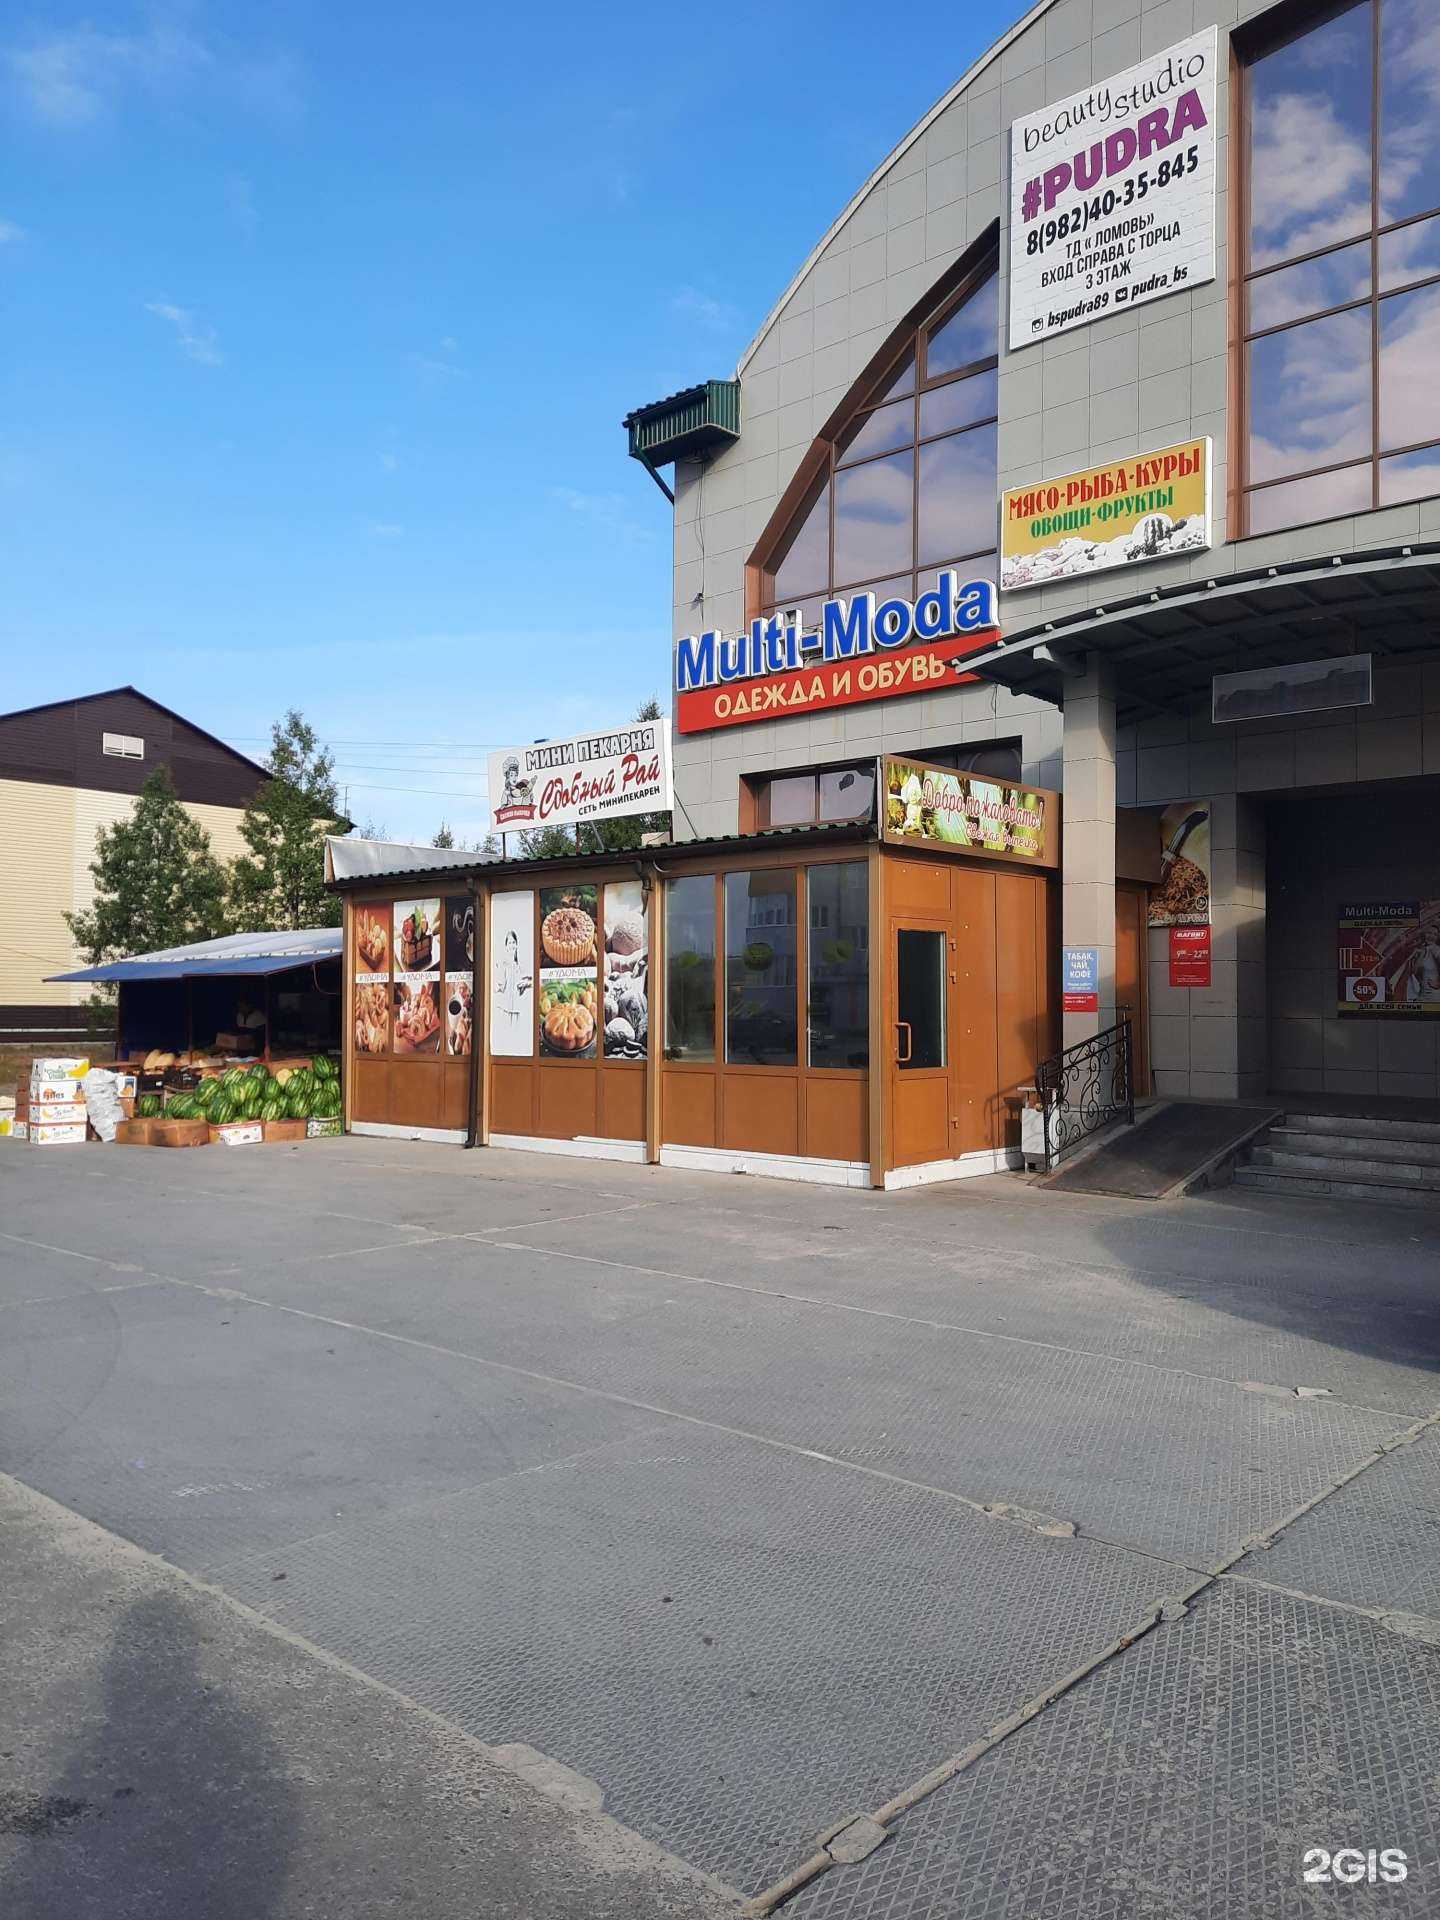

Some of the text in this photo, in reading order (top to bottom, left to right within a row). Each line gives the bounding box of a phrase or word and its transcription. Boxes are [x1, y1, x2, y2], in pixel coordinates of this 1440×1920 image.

[1021, 88, 1209, 223] #PUDRA
[1026, 145, 1199, 256] 8(982)40-35-845
[1041, 221, 1181, 288] ВХОД СПРАВА С ТОРЦА
[1066, 239, 1082, 259] ТД
[1085, 259, 1132, 290] 3 ЭТАЖ
[1131, 265, 1188, 301] pudra_bs
[1047, 292, 1110, 328] bspudra89
[676, 568, 1001, 692] Multi-Moda
[713, 652, 946, 718] ОДЕЖДА И ОБУВЬ
[525, 727, 655, 771] МИНИ ПЕКАРНЯ
[539, 752, 661, 820] Сдобный Рай
[578, 785, 660, 816] СЕТЬ МИНИПЕКАРЕН
[921, 778, 966, 825] Добро
[1345, 906, 1413, 917] Multi-Moda
[1070, 970, 1092, 978] КОФЕ
